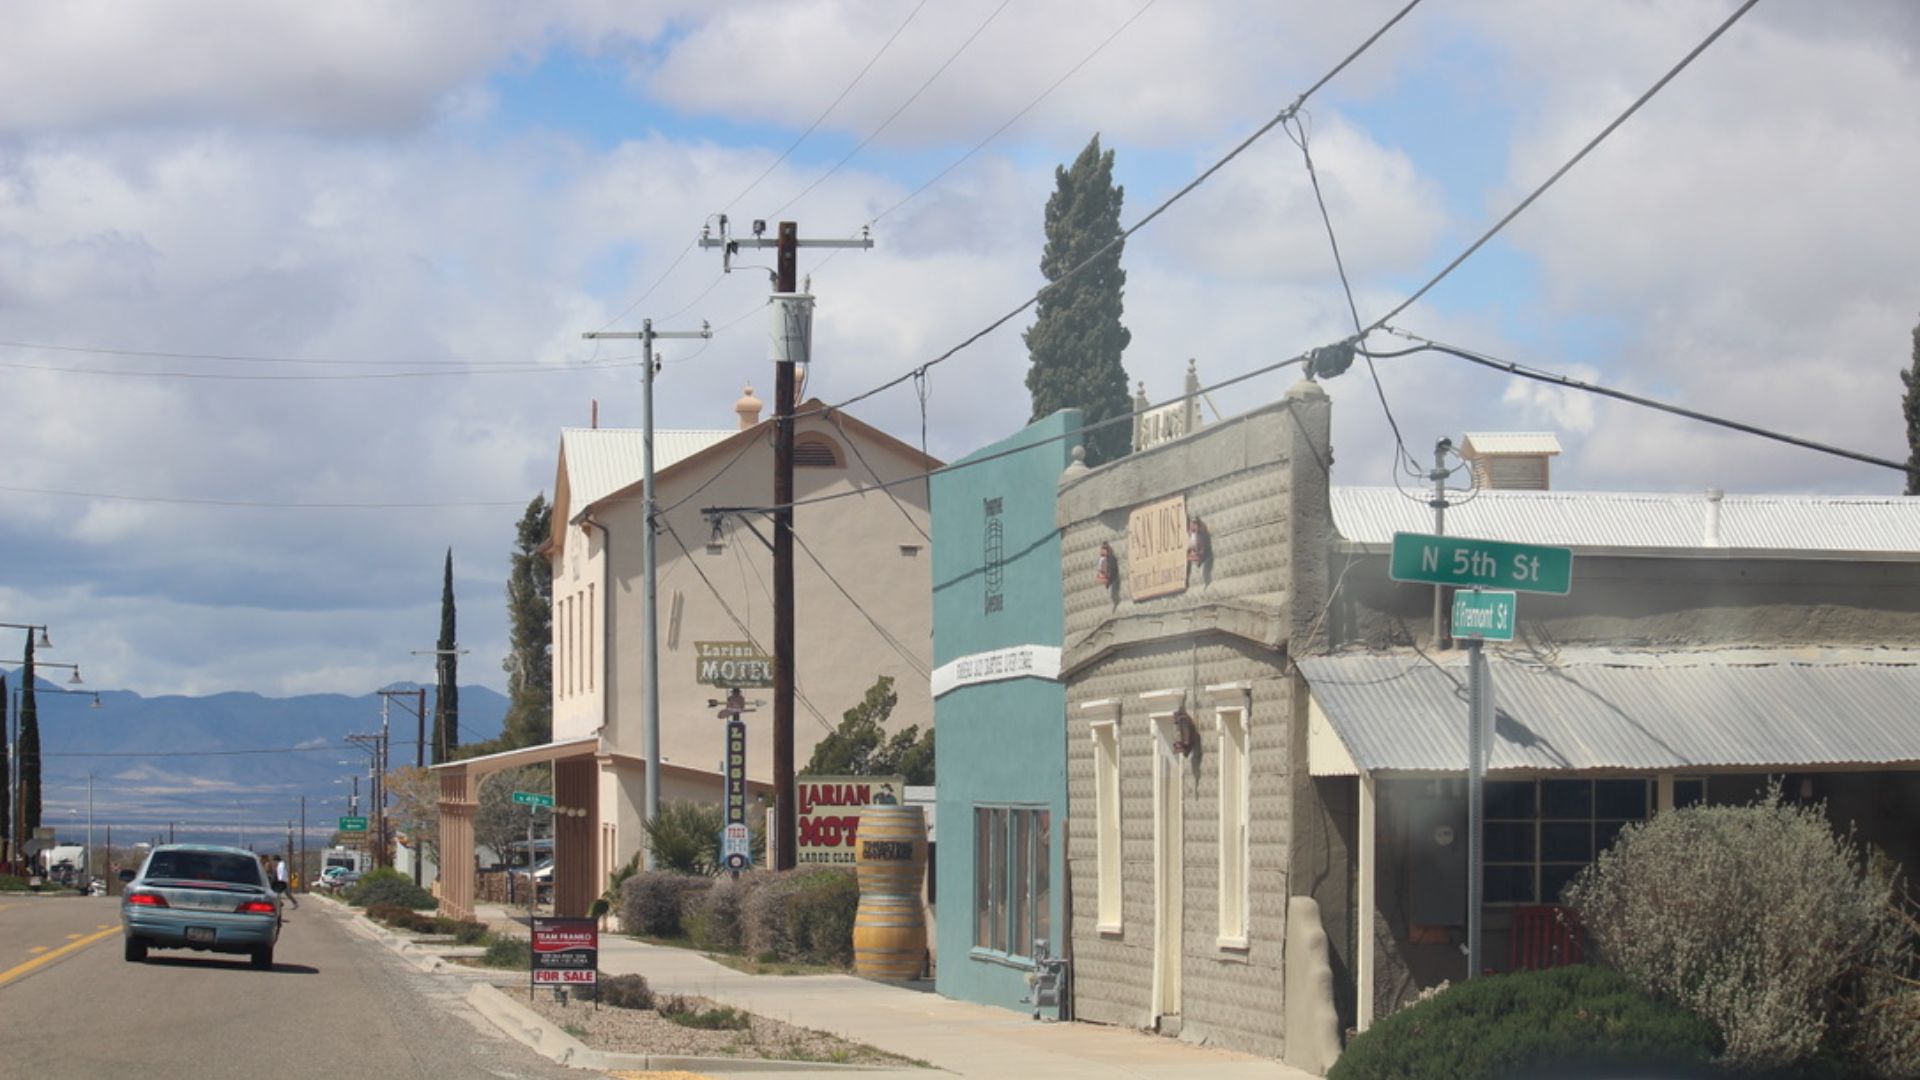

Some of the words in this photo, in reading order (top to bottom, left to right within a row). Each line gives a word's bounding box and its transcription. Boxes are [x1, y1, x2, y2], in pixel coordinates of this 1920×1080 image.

[1134, 512, 1154, 561] SAN
[1157, 502, 1183, 556] JOSE
[1421, 546, 1440, 573] N
[1452, 549, 1497, 578] 5th
[1512, 554, 1541, 582] St
[1460, 601, 1492, 629] Fremont
[1496, 603, 1508, 630] St
[702, 644, 752, 656] Larian
[702, 660, 774, 681] MOTEL
[730, 727, 743, 820] LODGING
[799, 783, 870, 815] LARIAN
[536, 971, 560, 982] FOR
[563, 971, 593, 982] SALE
